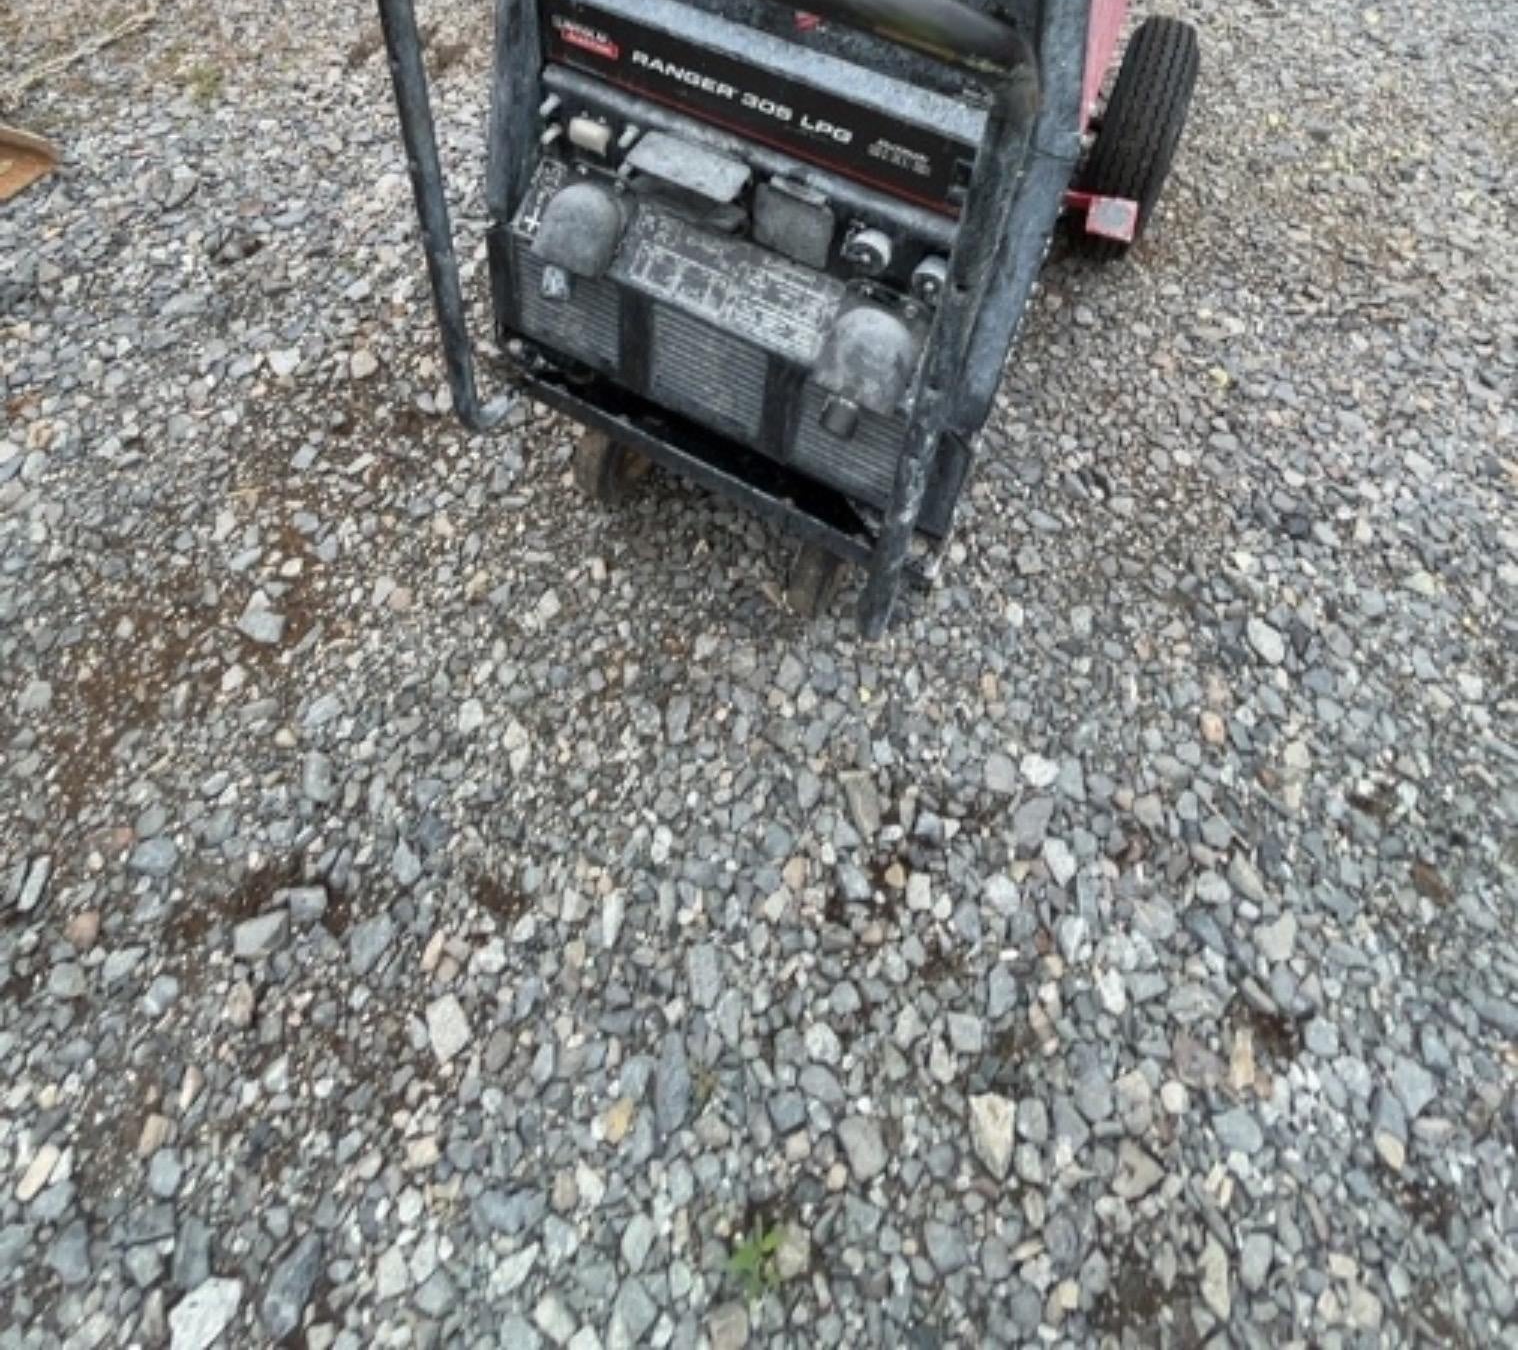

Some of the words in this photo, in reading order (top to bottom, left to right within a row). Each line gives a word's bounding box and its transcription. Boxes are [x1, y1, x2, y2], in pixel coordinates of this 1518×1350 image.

[632, 50, 735, 100] RANGER
[740, 92, 793, 122] 305
[800, 113, 853, 144] LPG
